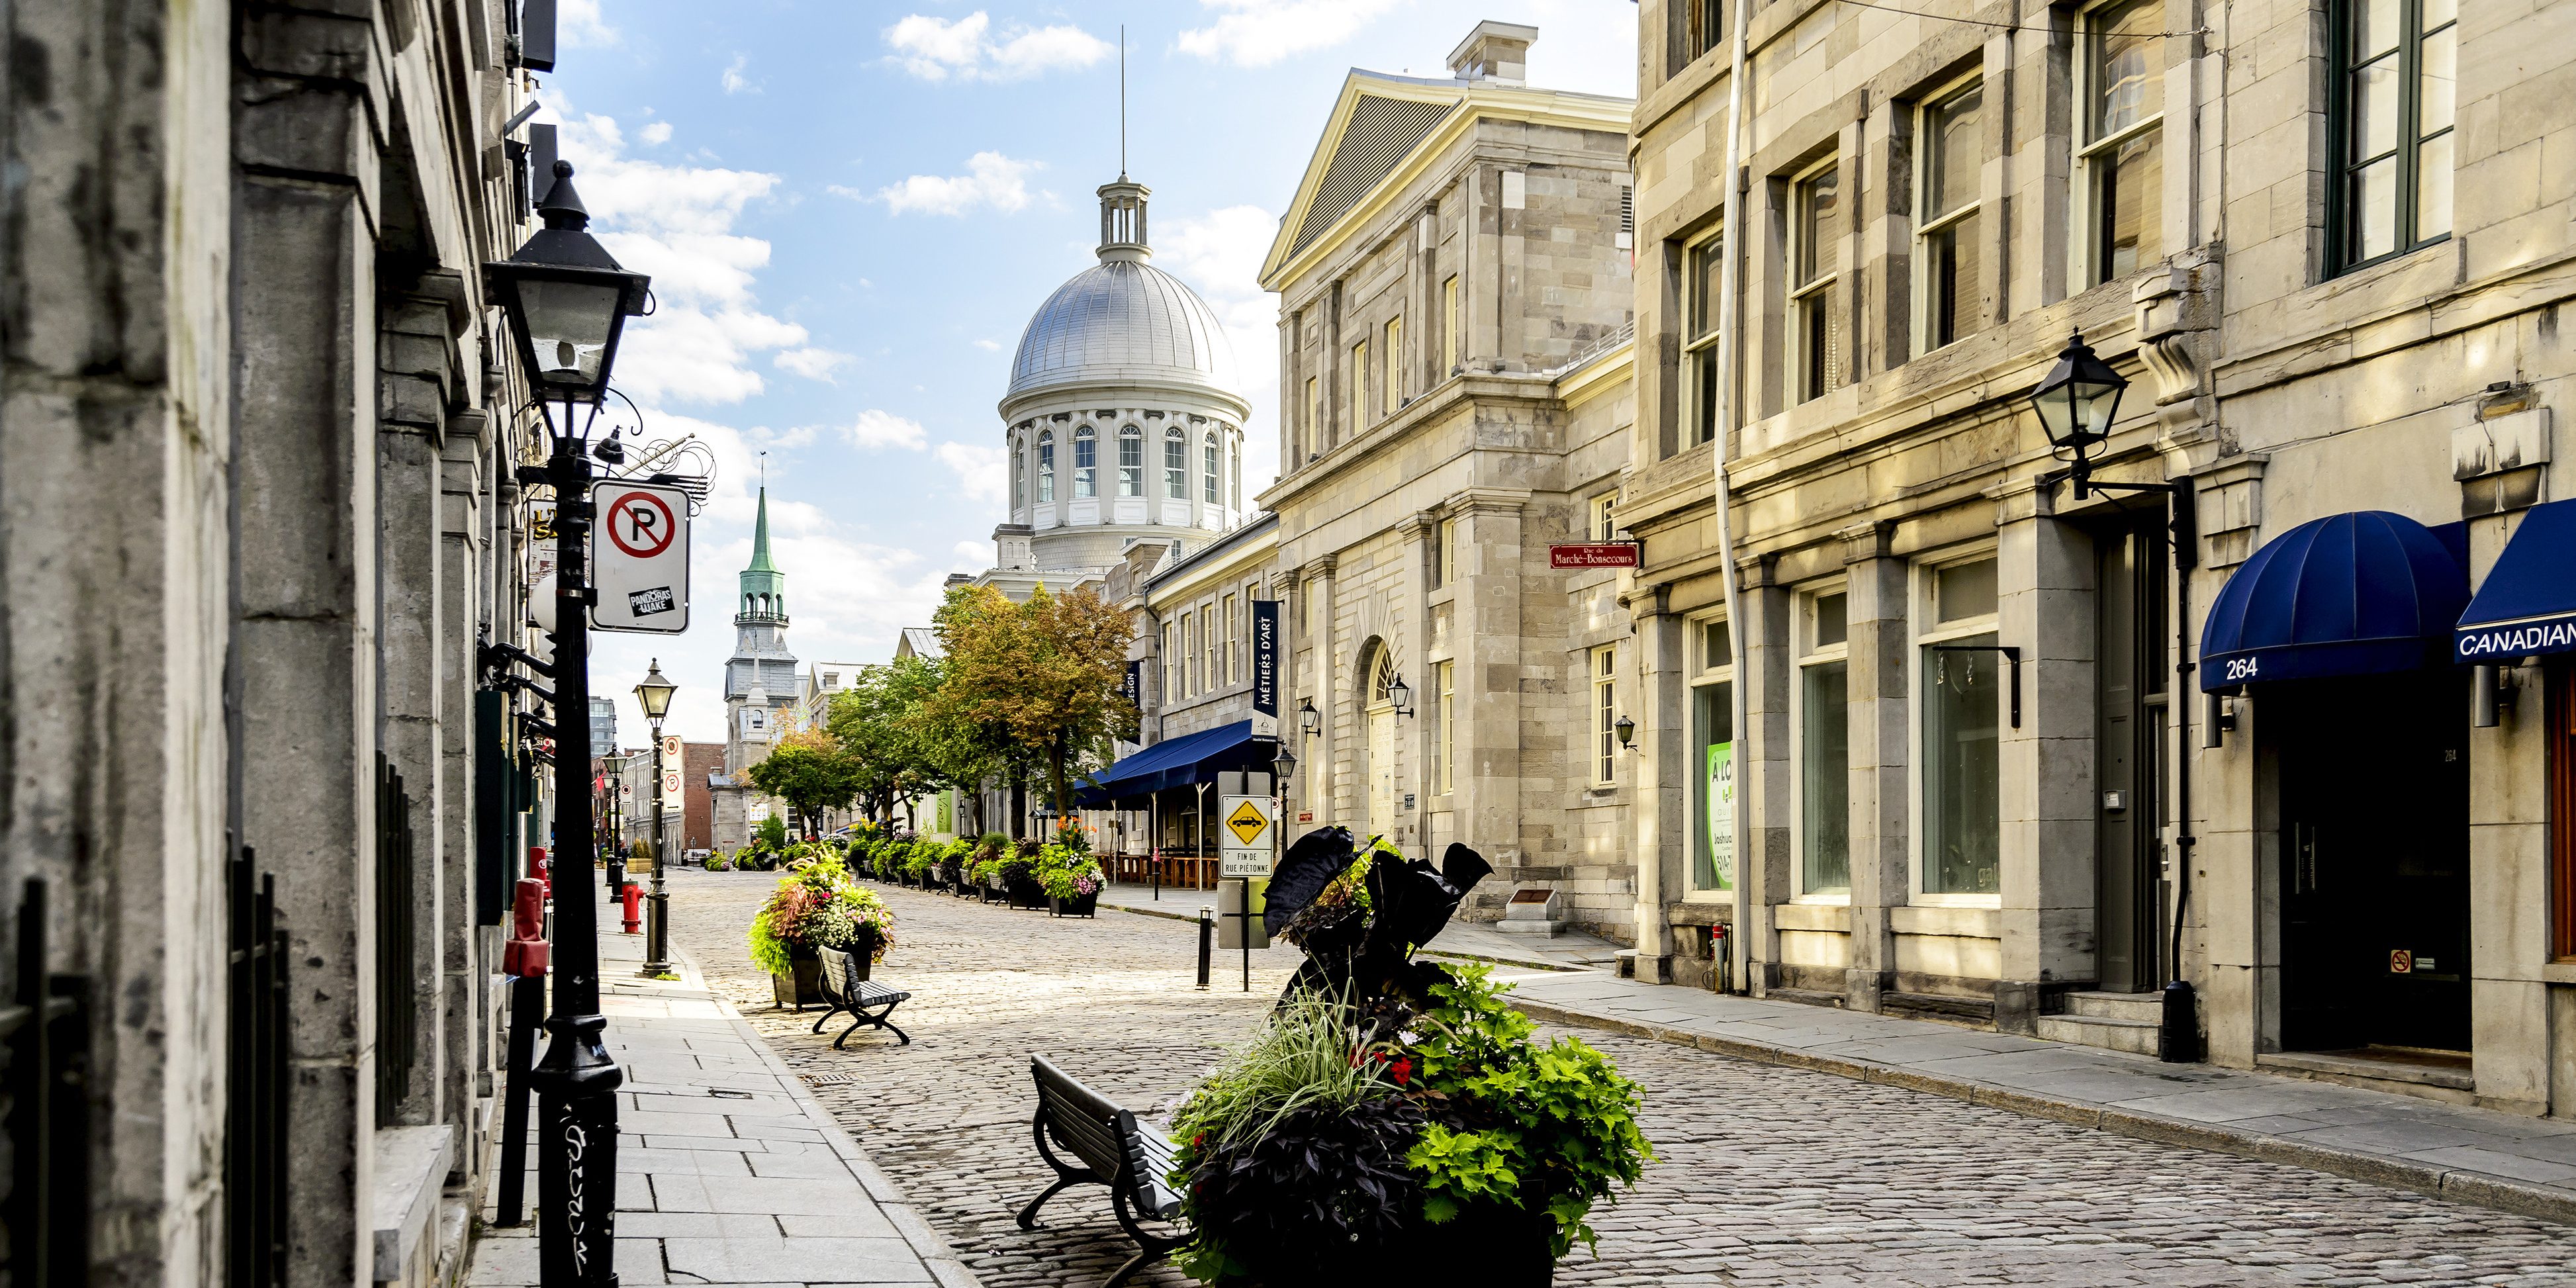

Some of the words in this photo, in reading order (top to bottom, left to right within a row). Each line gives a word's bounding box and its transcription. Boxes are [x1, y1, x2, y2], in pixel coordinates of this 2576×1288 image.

[1555, 554, 1633, 564] Marché-Bonsecours
[1260, 617, 1270, 649] D'ART
[2227, 657, 2258, 680] 264
[1260, 653, 1270, 705] MÉTIERS
[2445, 749, 2456, 762] 264
[1712, 756, 1719, 783] À
[1714, 831, 1732, 845] Joshua
[1225, 864, 1237, 872] RUE
